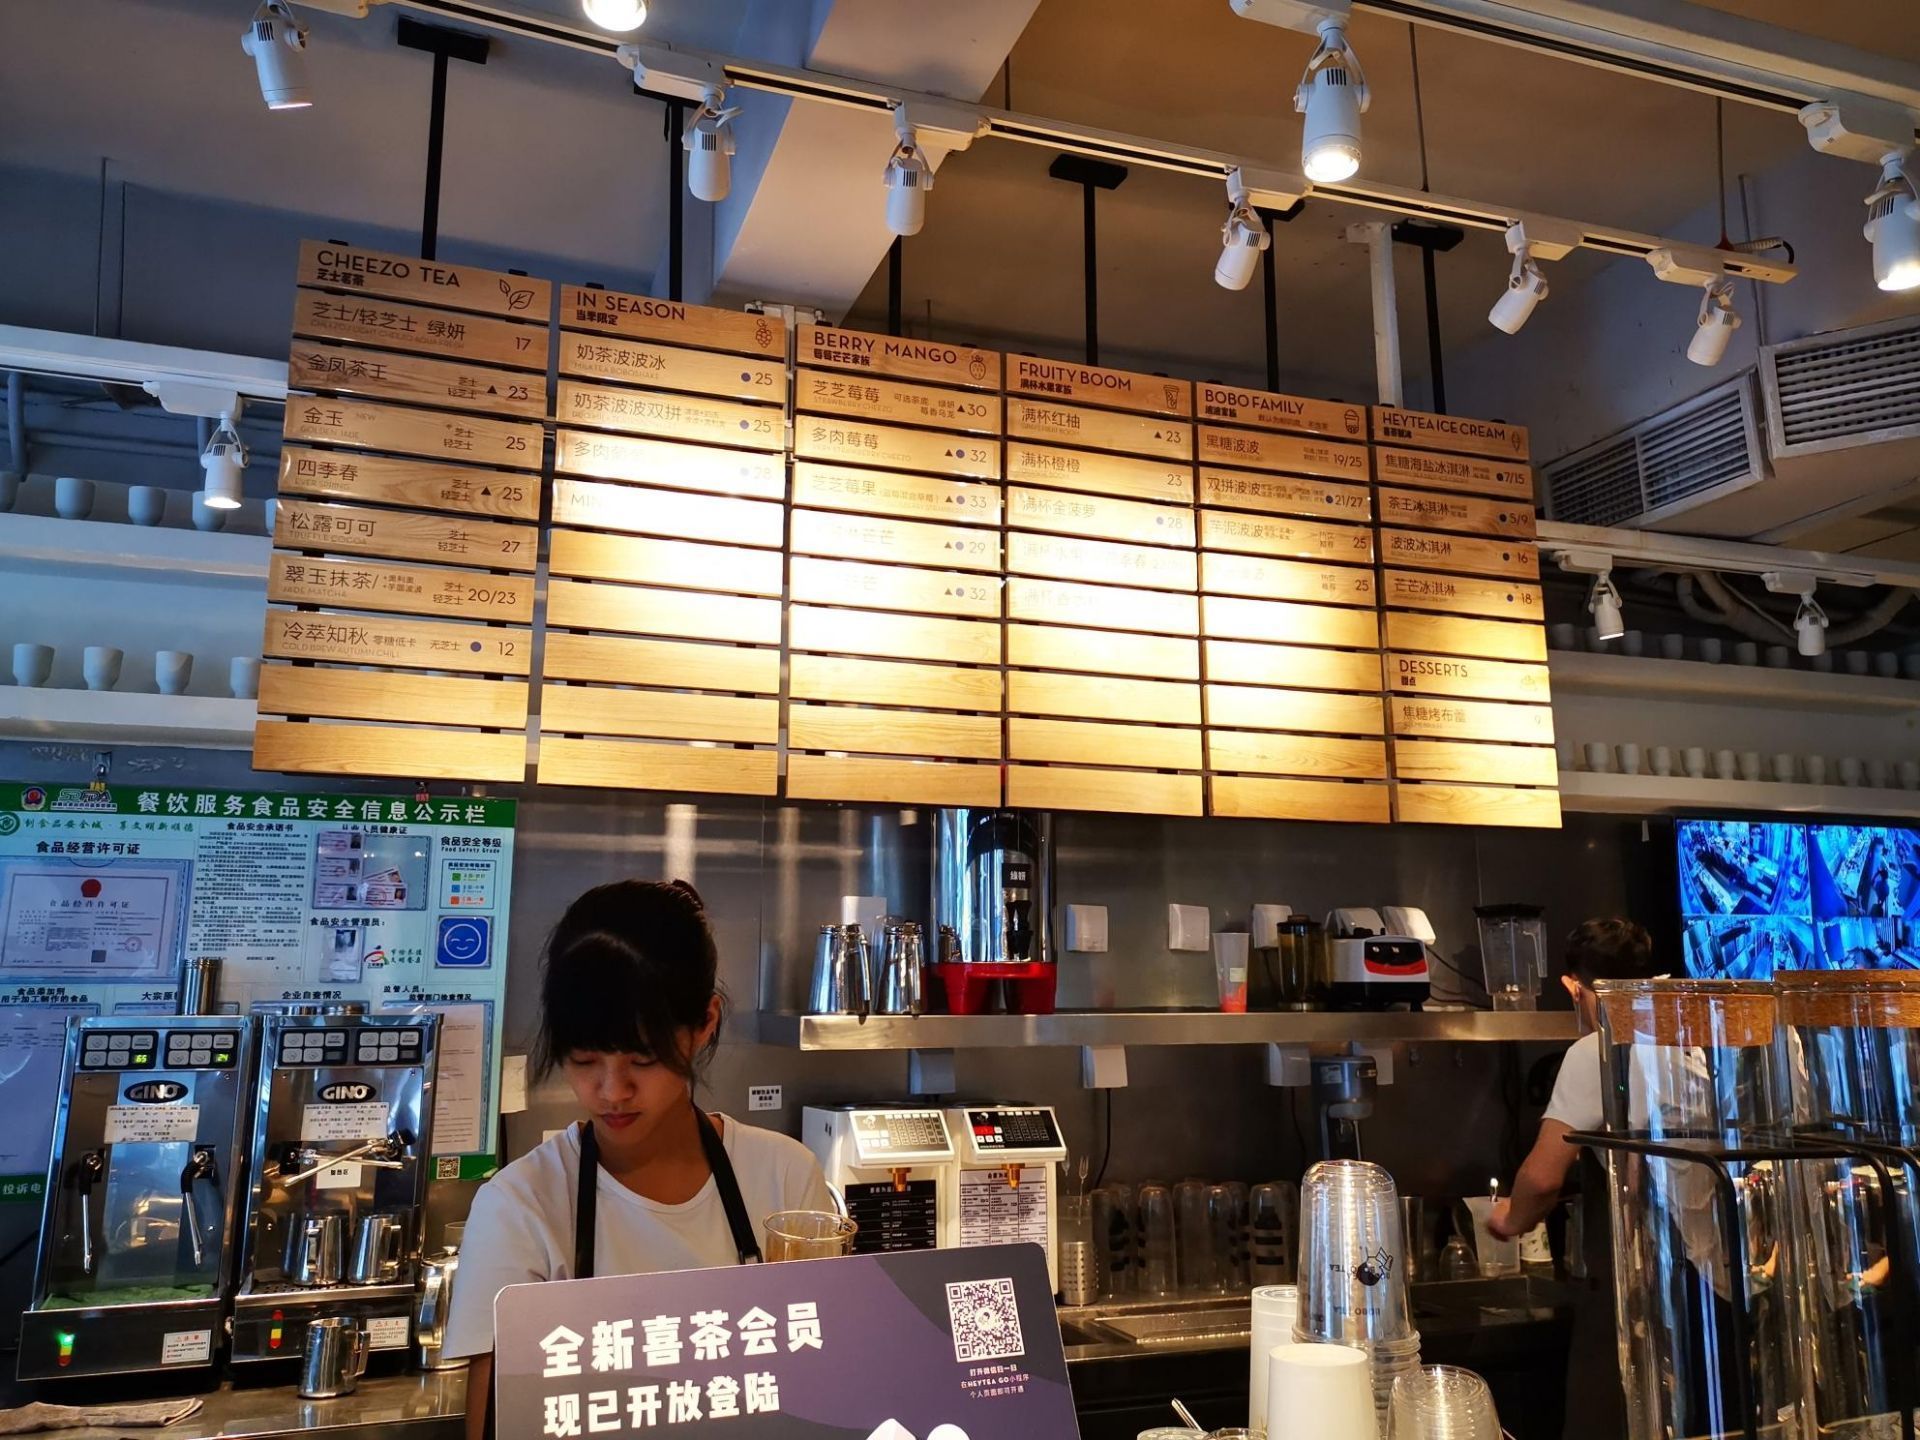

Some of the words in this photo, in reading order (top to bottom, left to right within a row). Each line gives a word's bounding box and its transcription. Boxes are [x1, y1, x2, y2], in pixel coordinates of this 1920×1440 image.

[317, 250, 410, 279] CHEEZO
[420, 266, 460, 287] TEA
[576, 291, 596, 308] IN
[605, 296, 685, 321] SEASON
[576, 310, 618, 326] 当季限定
[312, 301, 418, 332] 芝士/轻芝士
[427, 320, 466, 341] 绿妍
[515, 336, 532, 350] 17
[814, 331, 876, 352] BERRY
[884, 342, 957, 365] MANGO
[308, 354, 387, 381] 金凤茶王
[576, 343, 666, 371] 奶茶波波冰
[755, 372, 773, 386] 25
[1019, 362, 1077, 382] FRUITY
[1080, 372, 1131, 391] BOOM
[447, 387, 477, 400] 轻芝士
[457, 376, 478, 387] 芝士
[508, 385, 529, 400] 23
[812, 379, 881, 403] 芝芝莓莓
[967, 403, 988, 418] 30
[574, 392, 682, 421] 奶茶波波双拼
[753, 419, 772, 434] 25
[1205, 389, 1249, 408] BOBO
[1252, 396, 1305, 415] FAMILY
[303, 406, 344, 427] 金玉
[1021, 406, 1080, 430] 满杯红柚
[1166, 431, 1182, 444] 23
[1383, 412, 1434, 430] HEYTEA
[1437, 419, 1457, 434] ICE
[1459, 423, 1505, 441] CREAM
[443, 439, 473, 450] 轻芝士
[455, 427, 475, 439] 芝士
[505, 436, 526, 450] 25
[812, 426, 881, 450] 多肉莓莓
[970, 449, 988, 464] 32
[1206, 434, 1260, 455] 黑糖波波
[1333, 453, 1362, 468] 19/25
[297, 458, 359, 482] 四季春
[1021, 451, 1080, 474] 满杯橙橙
[1167, 473, 1182, 487] 23
[1385, 454, 1470, 478] 焦糖海盐冰淇淋
[1505, 472, 1525, 485] 7/15
[441, 490, 471, 501] 轻芝士
[452, 479, 472, 489] 芝士
[502, 486, 523, 501] 25
[811, 474, 876, 497] 芝芝莓果
[969, 495, 988, 509] 33
[1207, 477, 1261, 496] 双拼波波
[1335, 495, 1363, 508] 21/27
[1388, 496, 1450, 516] 茶王冰淇淋
[1510, 513, 1529, 525] 5/9
[290, 511, 377, 537] 松露可可
[438, 542, 468, 553] 轻芝士
[449, 530, 469, 540] 芝士
[502, 541, 521, 553] 27
[968, 541, 987, 555] 29
[1353, 536, 1367, 549] 25
[1391, 536, 1452, 556] 波波冰淇淋
[1517, 552, 1528, 563] 16
[285, 565, 379, 590] 翠玉抹茶/
[1355, 579, 1369, 591] 25
[433, 593, 463, 605] 轻芝士
[443, 582, 464, 592] 芝士
[468, 588, 516, 605] 20/23
[969, 587, 987, 602] 32
[1394, 578, 1456, 597] 芒芒冰淇淋
[1521, 593, 1533, 604] 18
[283, 621, 368, 646] 冷萃知秋
[430, 638, 462, 651] 无芝士
[498, 641, 514, 657] 12
[1400, 660, 1468, 677] DESSERTS
[1403, 705, 1466, 723] 焦糖烤布蕾
[137, 791, 486, 825] 餐饮服务食品安全信息公示栏
[226, 822, 294, 833] 食品安全承诺书
[36, 840, 141, 855] 食品经营许可证
[441, 836, 502, 848] 食品安全等级
[282, 990, 342, 1000] 企业自查情况
[135, 1054, 147, 1063] 65
[3, 1182, 43, 1195] 投诉电
[538, 1301, 824, 1379] 全新喜茶会员
[543, 1372, 781, 1438] 现已开放登陆
